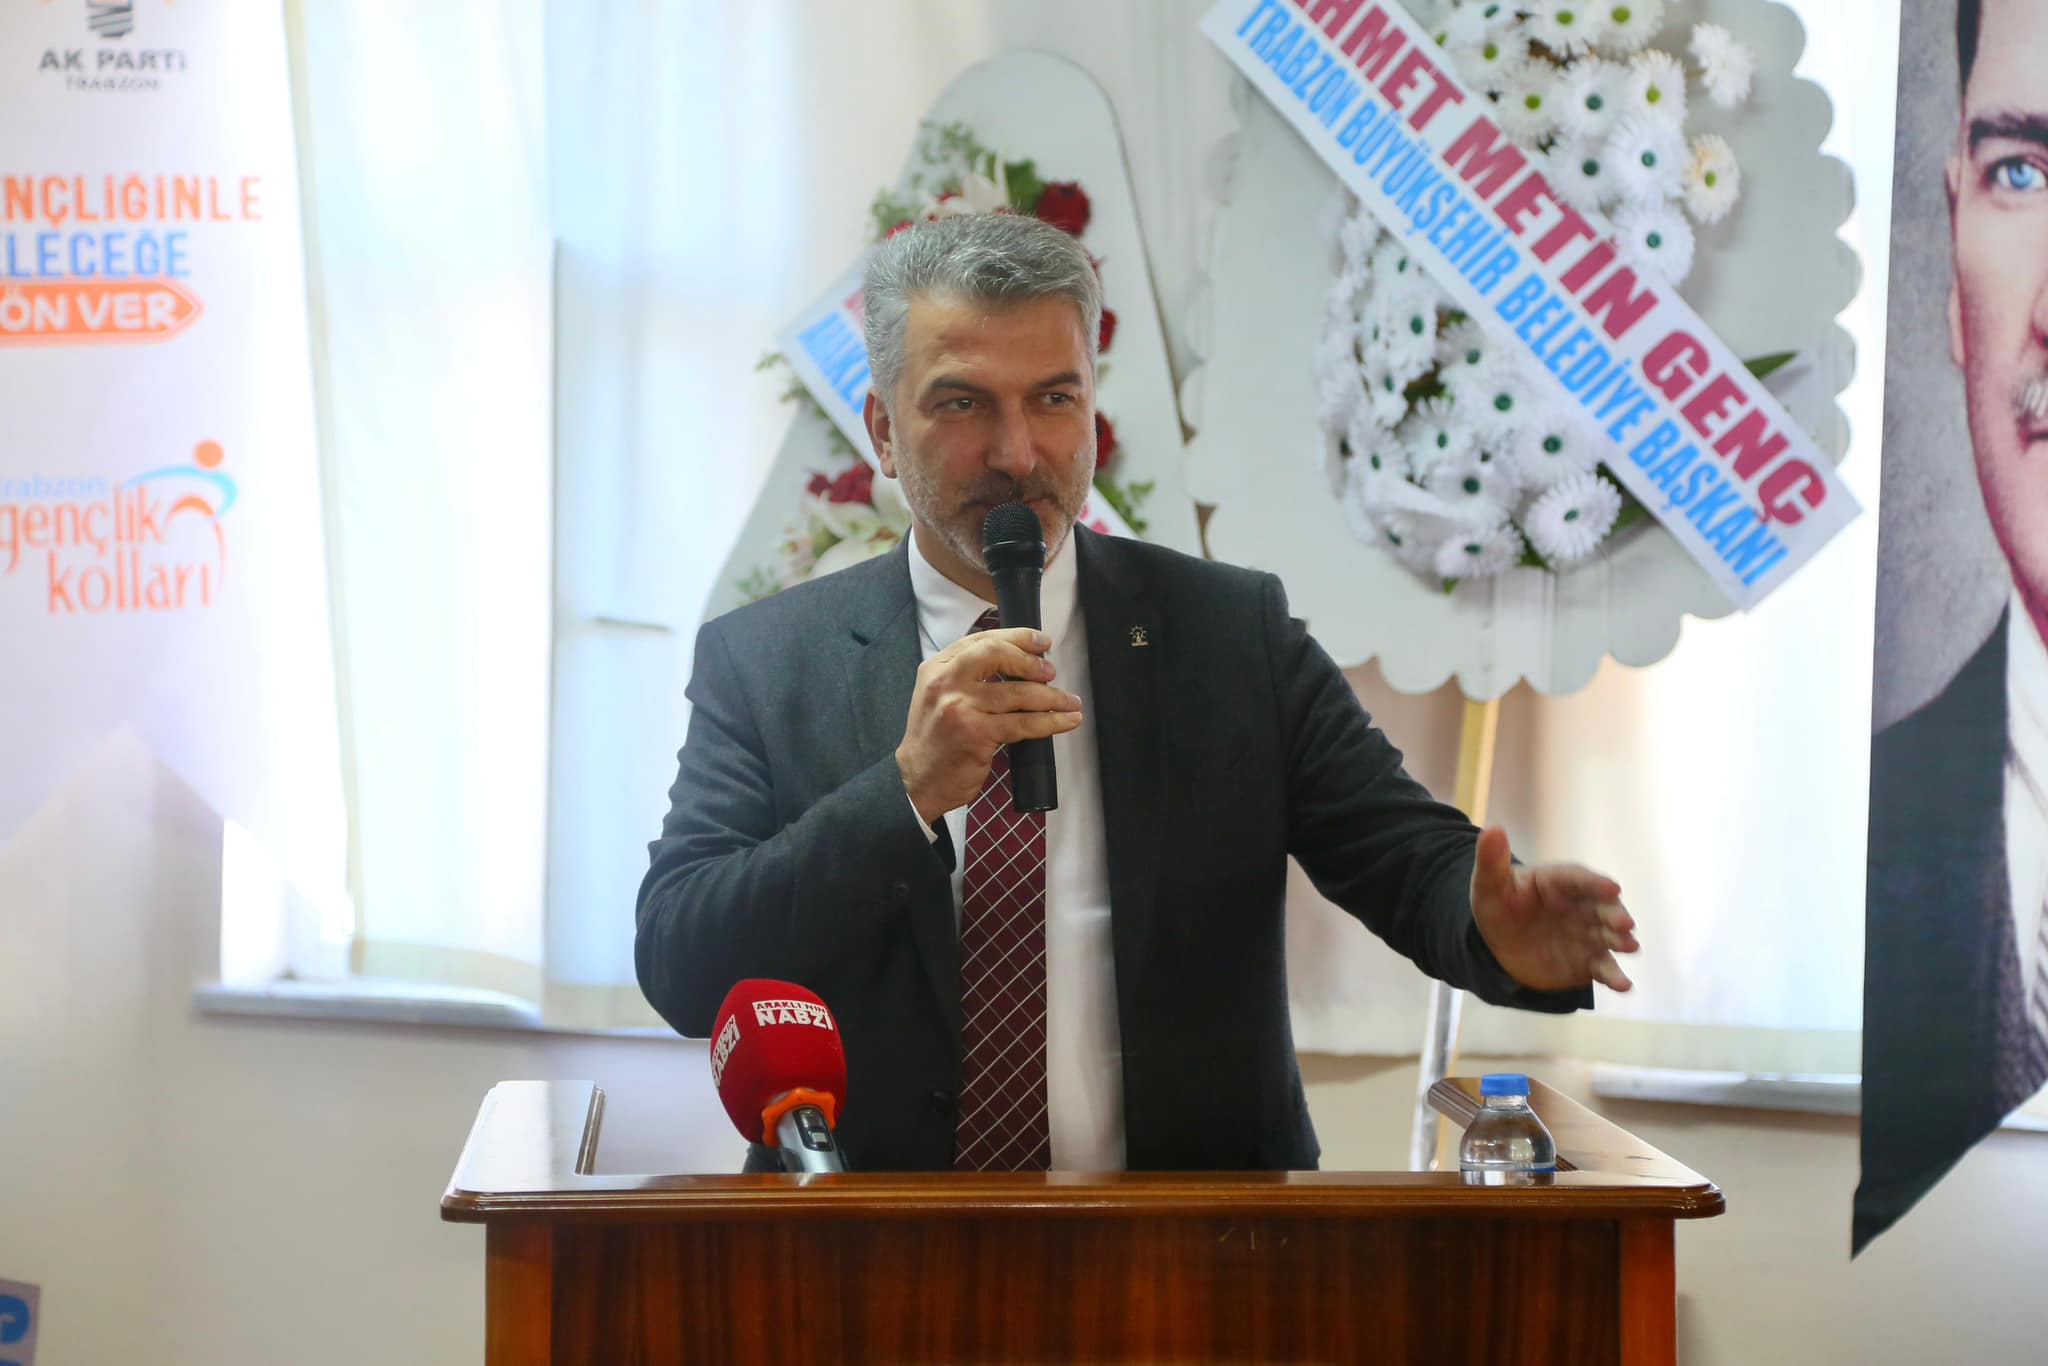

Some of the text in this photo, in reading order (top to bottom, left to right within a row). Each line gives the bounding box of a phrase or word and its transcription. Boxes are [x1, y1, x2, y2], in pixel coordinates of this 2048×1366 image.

[38, 48, 84, 71] AK
[1235, 0, 1361, 130] TRABZON
[1336, 99, 1521, 297] BÜYÜKŞEHİR
[1493, 272, 1659, 444] BELEDİYE
[0, 230, 190, 278] LECEĞE
[1291, 0, 1467, 133] HMET
[1641, 328, 1827, 527] GENÇ
[0, 286, 177, 331] ÖN VER
